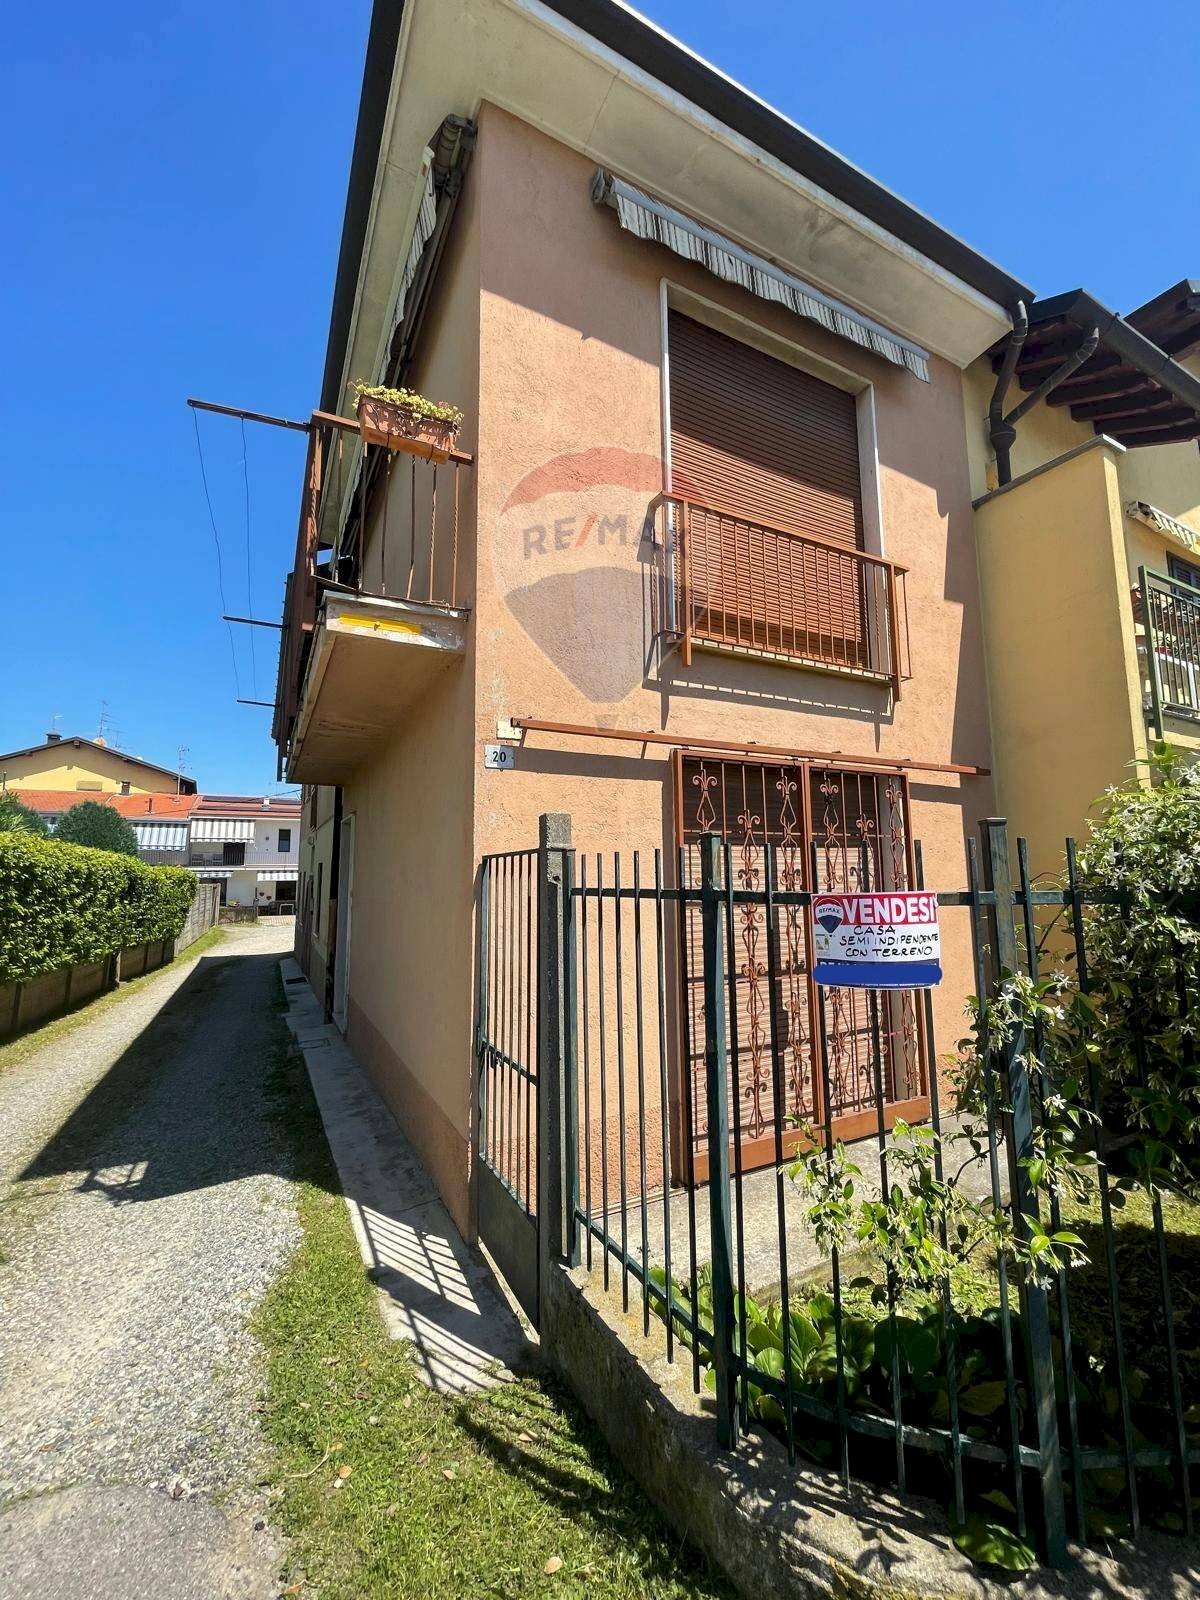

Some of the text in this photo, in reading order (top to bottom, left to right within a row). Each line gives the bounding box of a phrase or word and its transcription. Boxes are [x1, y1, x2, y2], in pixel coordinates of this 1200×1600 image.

[492, 751, 507, 762] 20
[843, 896, 936, 924] VENDESI
[853, 925, 896, 936] CASA
[845, 946, 933, 957] CON TERRENO
